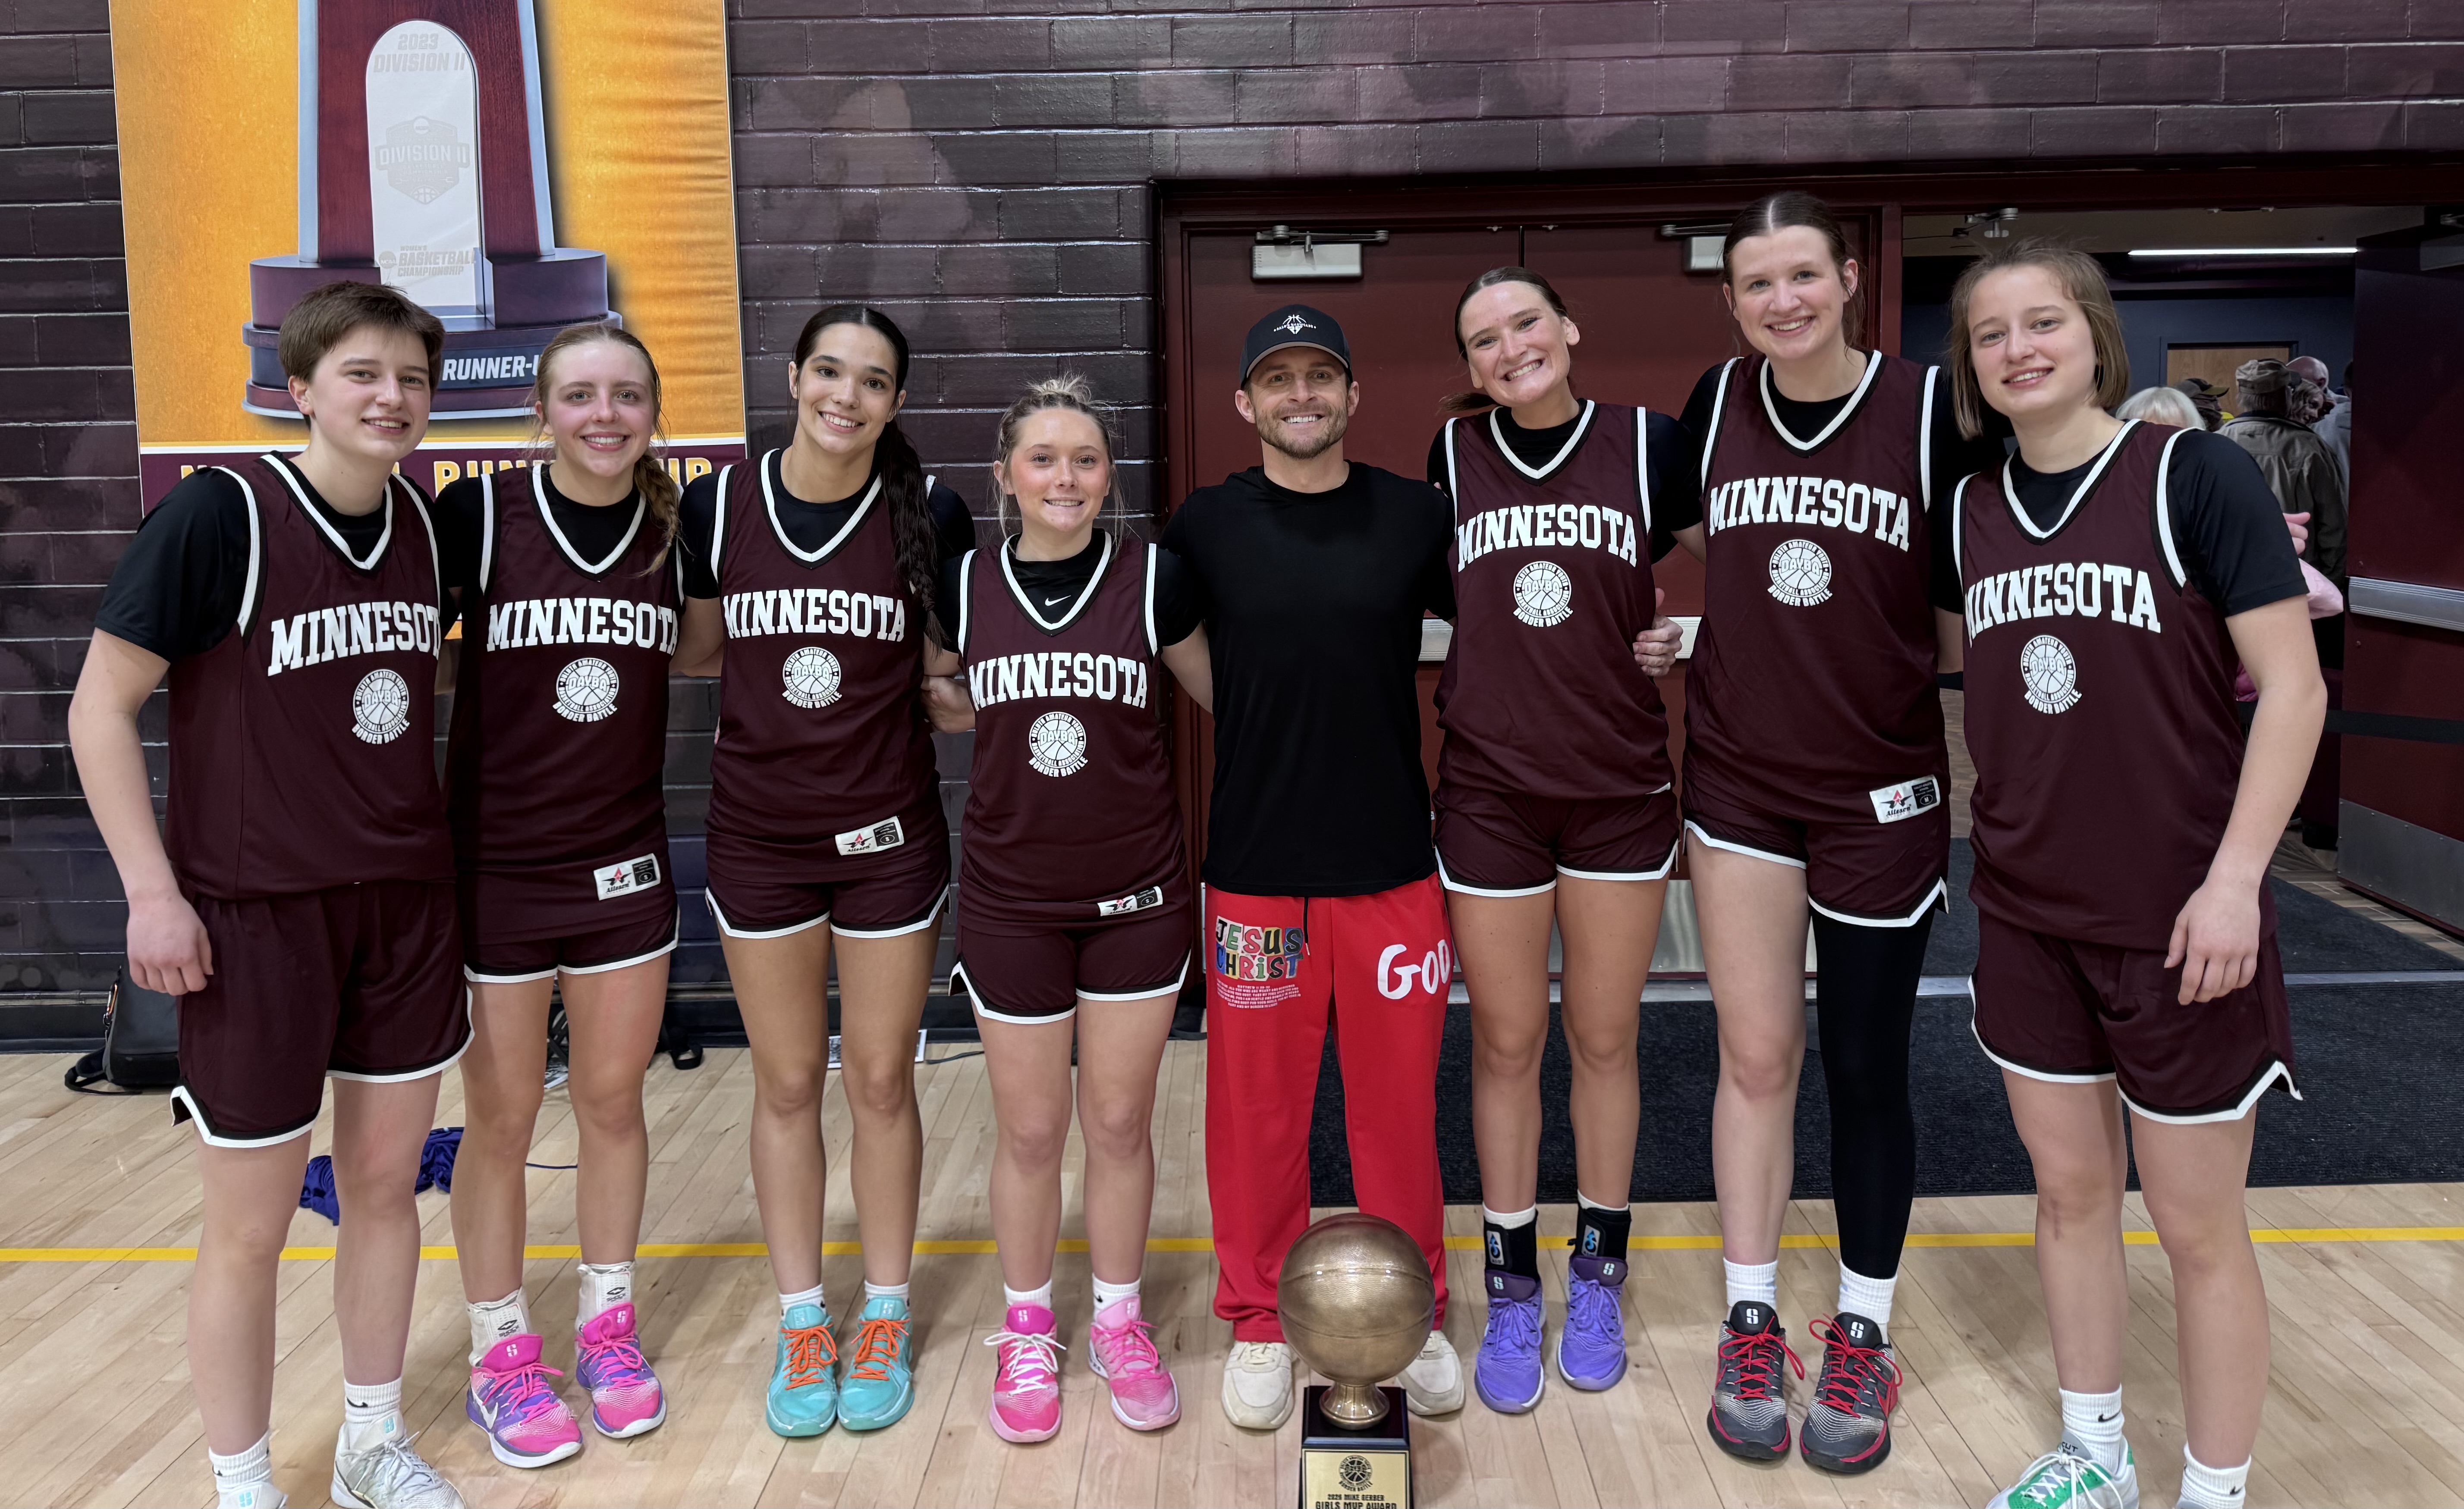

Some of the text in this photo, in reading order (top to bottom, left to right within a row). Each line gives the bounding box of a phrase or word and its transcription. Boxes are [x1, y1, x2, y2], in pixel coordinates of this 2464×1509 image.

[398, 33, 438, 50] 2023
[374, 52, 465, 72] DIVISION II
[380, 145, 466, 166] DIVISION II
[399, 251, 476, 266] BASKETBALL
[398, 266, 464, 276] CHAMPIONSHIP
[1709, 477, 1909, 552] MINNESOTA
[1458, 504, 1637, 573] MINNESOTA
[1781, 558, 1819, 576] DAYBA
[1524, 579, 1560, 596] DAYBA
[1767, 585, 1832, 606] BORDER BATTLE
[723, 589, 904, 642] MINNESOTA
[1965, 563, 2161, 648] MINNESOTA
[487, 598, 678, 656] MINNESOTA
[1513, 606, 1573, 627] BORDER BATTLE
[794, 665, 830, 680] DAYBA
[2031, 657, 2065, 677] DAYBA
[568, 676, 607, 692] DAYBA
[968, 653, 1147, 712] MINNESOTA
[364, 690, 399, 709] DAYBA
[782, 690, 842, 709] BORDER BATTLE
[2024, 689, 2082, 714] BORDER BATTLE
[553, 701, 617, 722] BORDER BATTLE
[352, 718, 410, 744] BORDER BATTLE
[1040, 730, 1075, 746] DAYBA
[1029, 756, 1088, 777] BORDER BATTLE
[1216, 919, 1301, 954] JESUS
